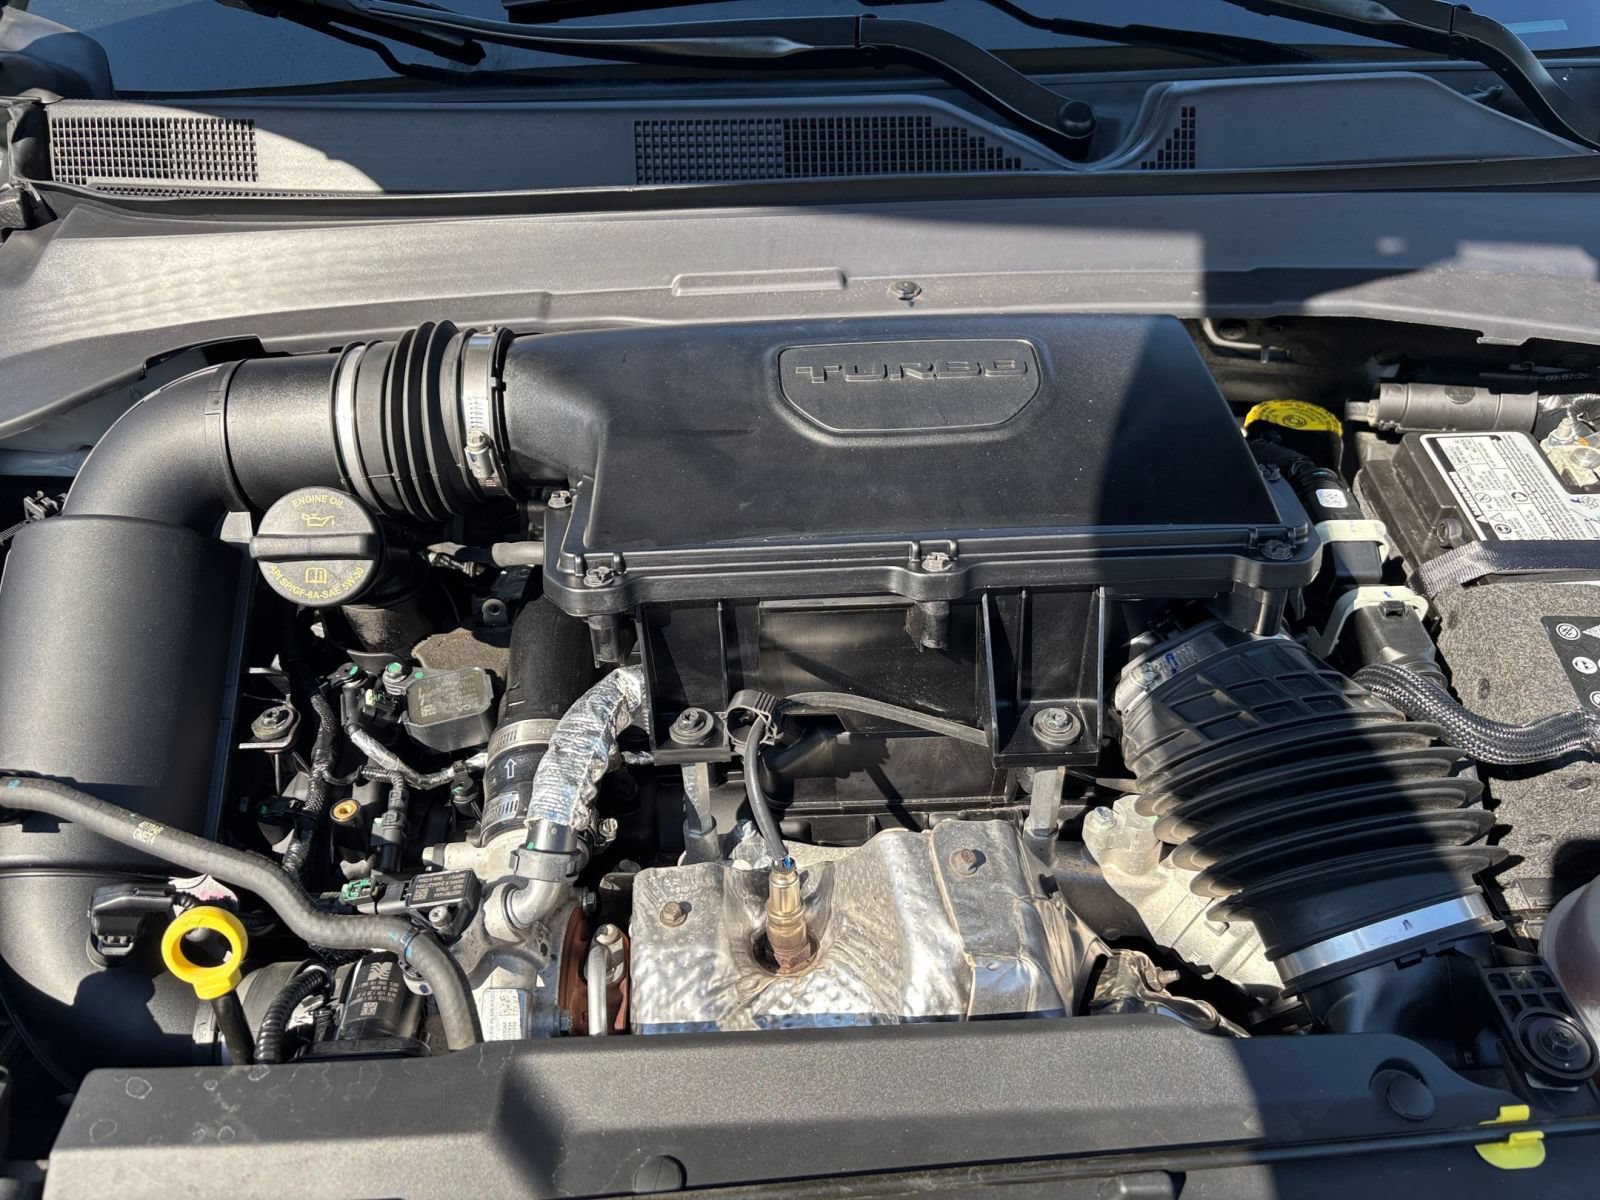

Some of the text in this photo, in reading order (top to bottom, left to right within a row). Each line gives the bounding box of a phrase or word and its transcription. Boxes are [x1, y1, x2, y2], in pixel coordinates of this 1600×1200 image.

[795, 359, 1028, 384] TURBO
[292, 494, 344, 509] ENGINE OIL
